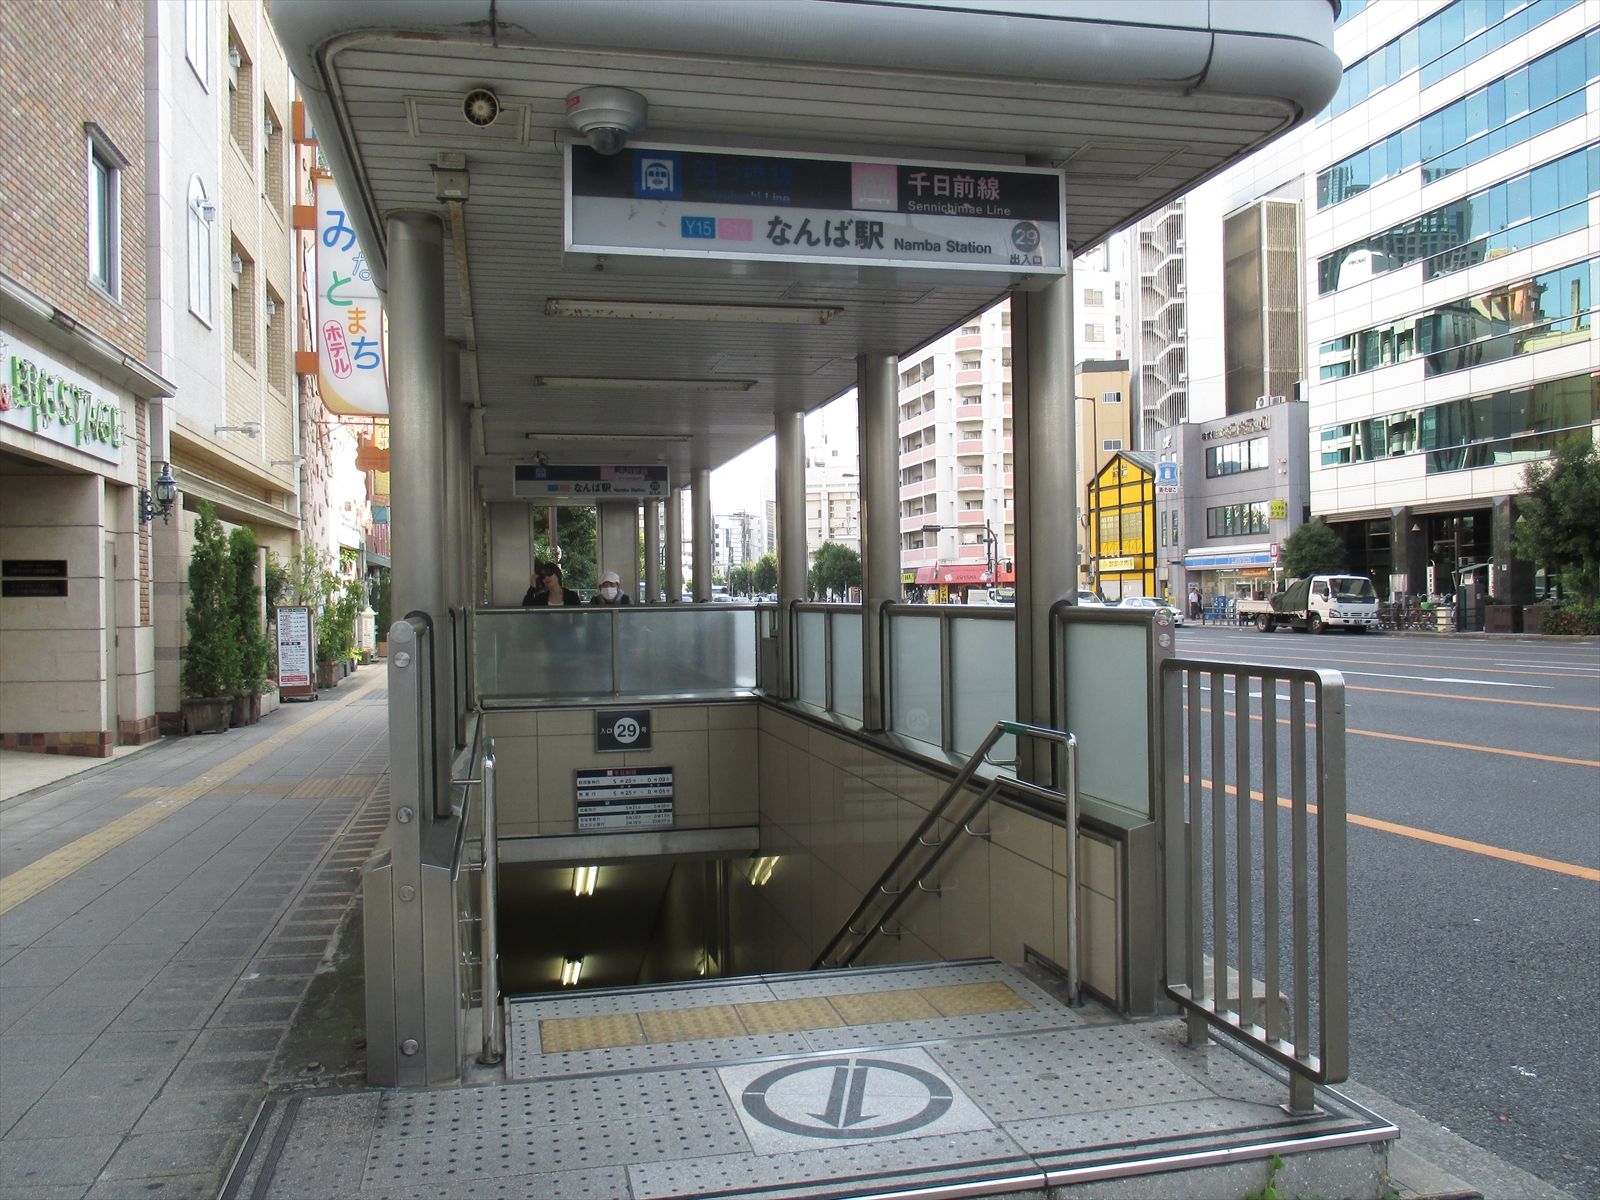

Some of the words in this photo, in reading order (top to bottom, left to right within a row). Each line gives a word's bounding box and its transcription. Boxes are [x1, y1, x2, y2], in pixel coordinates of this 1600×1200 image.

[908, 172, 1000, 200] 千日前線
[908, 201, 984, 215] Sennichimae
[986, 204, 1011, 216] Line
[685, 220, 712, 236] Y15
[766, 215, 884, 250] なんば駅
[1015, 228, 1037, 245] 29
[894, 237, 941, 252] Namba
[946, 240, 992, 254] Station
[1010, 254, 1043, 266] 出入口
[325, 325, 350, 375] ホテル
[616, 723, 637, 738] 29
